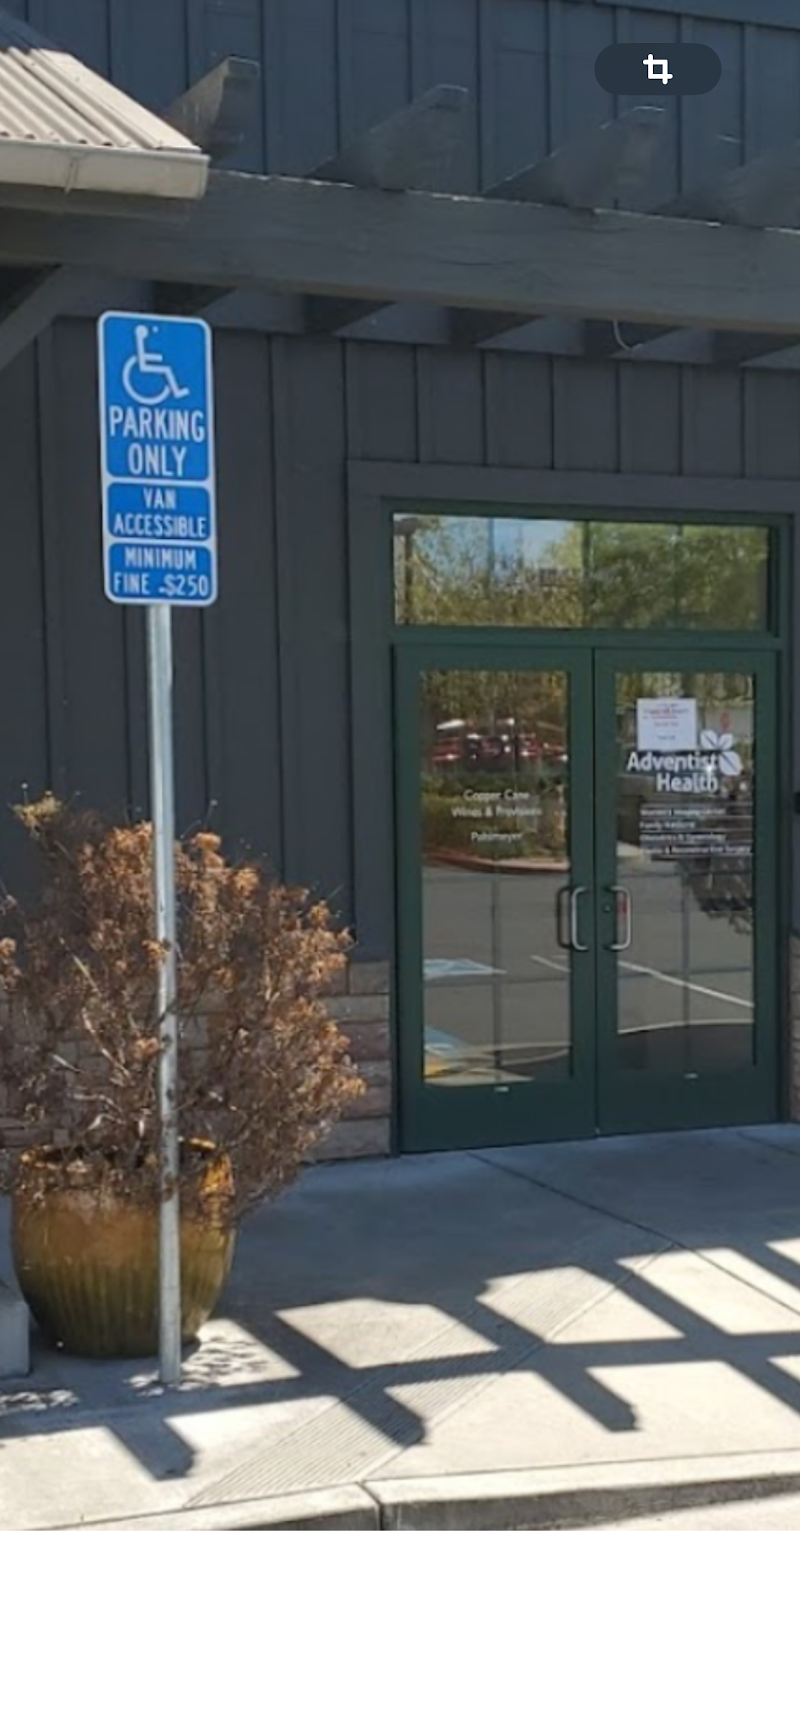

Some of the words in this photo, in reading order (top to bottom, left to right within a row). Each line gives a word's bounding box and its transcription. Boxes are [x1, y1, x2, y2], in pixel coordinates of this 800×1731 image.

[109, 406, 205, 442] PARKING
[128, 443, 187, 477] ONLY
[144, 489, 176, 510] VAN
[114, 513, 207, 538] ACCESSIBLE
[125, 547, 196, 570] MINIMUM
[114, 574, 150, 595] FINE
[627, 751, 719, 772] Adventist
[656, 773, 719, 793] Health
[463, 788, 501, 802] Copper
